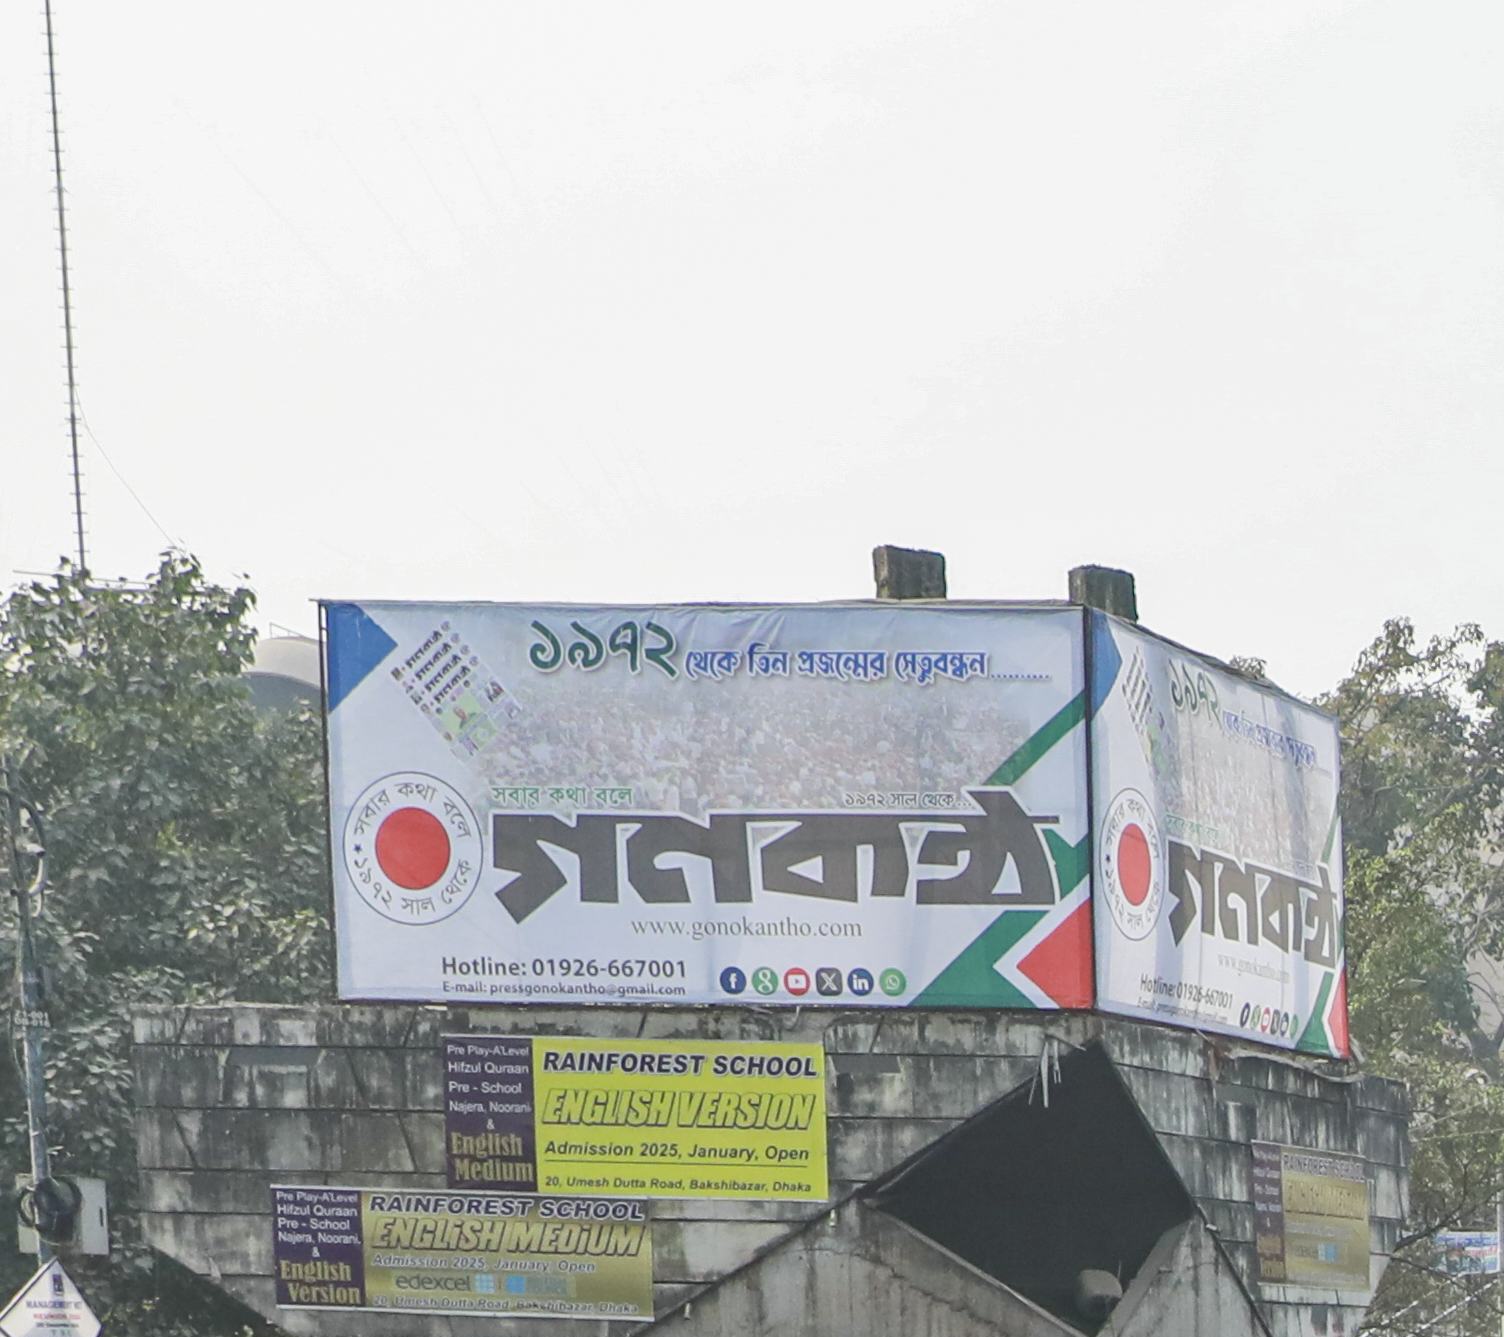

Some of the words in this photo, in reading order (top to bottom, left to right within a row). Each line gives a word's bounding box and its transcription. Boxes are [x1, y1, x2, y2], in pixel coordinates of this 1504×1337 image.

[528, 617, 679, 679] ১৯৭২
[684, 647, 739, 678] থেকে
[747, 641, 788, 676] তিন
[796, 648, 886, 683] প্রজন্মের
[492, 786, 539, 805] সবার
[549, 786, 587, 804] কথা
[594, 786, 633, 804] বলে
[631, 916, 863, 942] www.gonokantho.com
[441, 956, 527, 977] Hotline:
[531, 958, 687, 979] 01926-667001
[442, 981, 488, 993] E-mail:
[489, 982, 686, 998] pressgonokantho@gmail.com
[447, 1045, 465, 1056] Pre
[447, 1061, 481, 1074] Hifzul
[484, 1062, 530, 1075] Quraan
[542, 1052, 706, 1076] RAINFOREST
[712, 1054, 819, 1078] SCHOOL
[449, 1081, 470, 1094] Pre
[481, 1082, 523, 1095] School
[541, 1088, 672, 1127] ENGLISH
[676, 1091, 816, 1130] VERSION
[486, 1118, 496, 1130] &
[450, 1131, 524, 1158] English
[544, 1141, 635, 1157] Admission
[640, 1143, 683, 1159] 2025,
[687, 1144, 759, 1162] January,
[764, 1147, 810, 1162] Open
[454, 1157, 534, 1183] Medium
[545, 1176, 562, 1189] 20,
[566, 1177, 609, 1189] Umesh
[613, 1177, 647, 1190] Dutta
[650, 1178, 684, 1191] Road,
[689, 1180, 769, 1193] Bakshibazar,
[773, 1181, 812, 1193] Dhaka
[276, 1191, 294, 1202] Pre
[277, 1204, 311, 1216] Hifzul
[312, 1205, 358, 1217] Quraan
[369, 1195, 534, 1218] RAINFOREST
[539, 1198, 645, 1220] SCHOOL
[277, 1218, 299, 1229] Pre
[310, 1219, 351, 1231] School
[311, 1247, 321, 1259] &
[279, 1259, 352, 1283] English
[373, 1254, 449, 1268] Admission
[557, 1260, 596, 1273] Open
[395, 1273, 471, 1292] edexcel
[286, 1283, 361, 1307] Version
[599, 1301, 639, 1314] Dhaka
